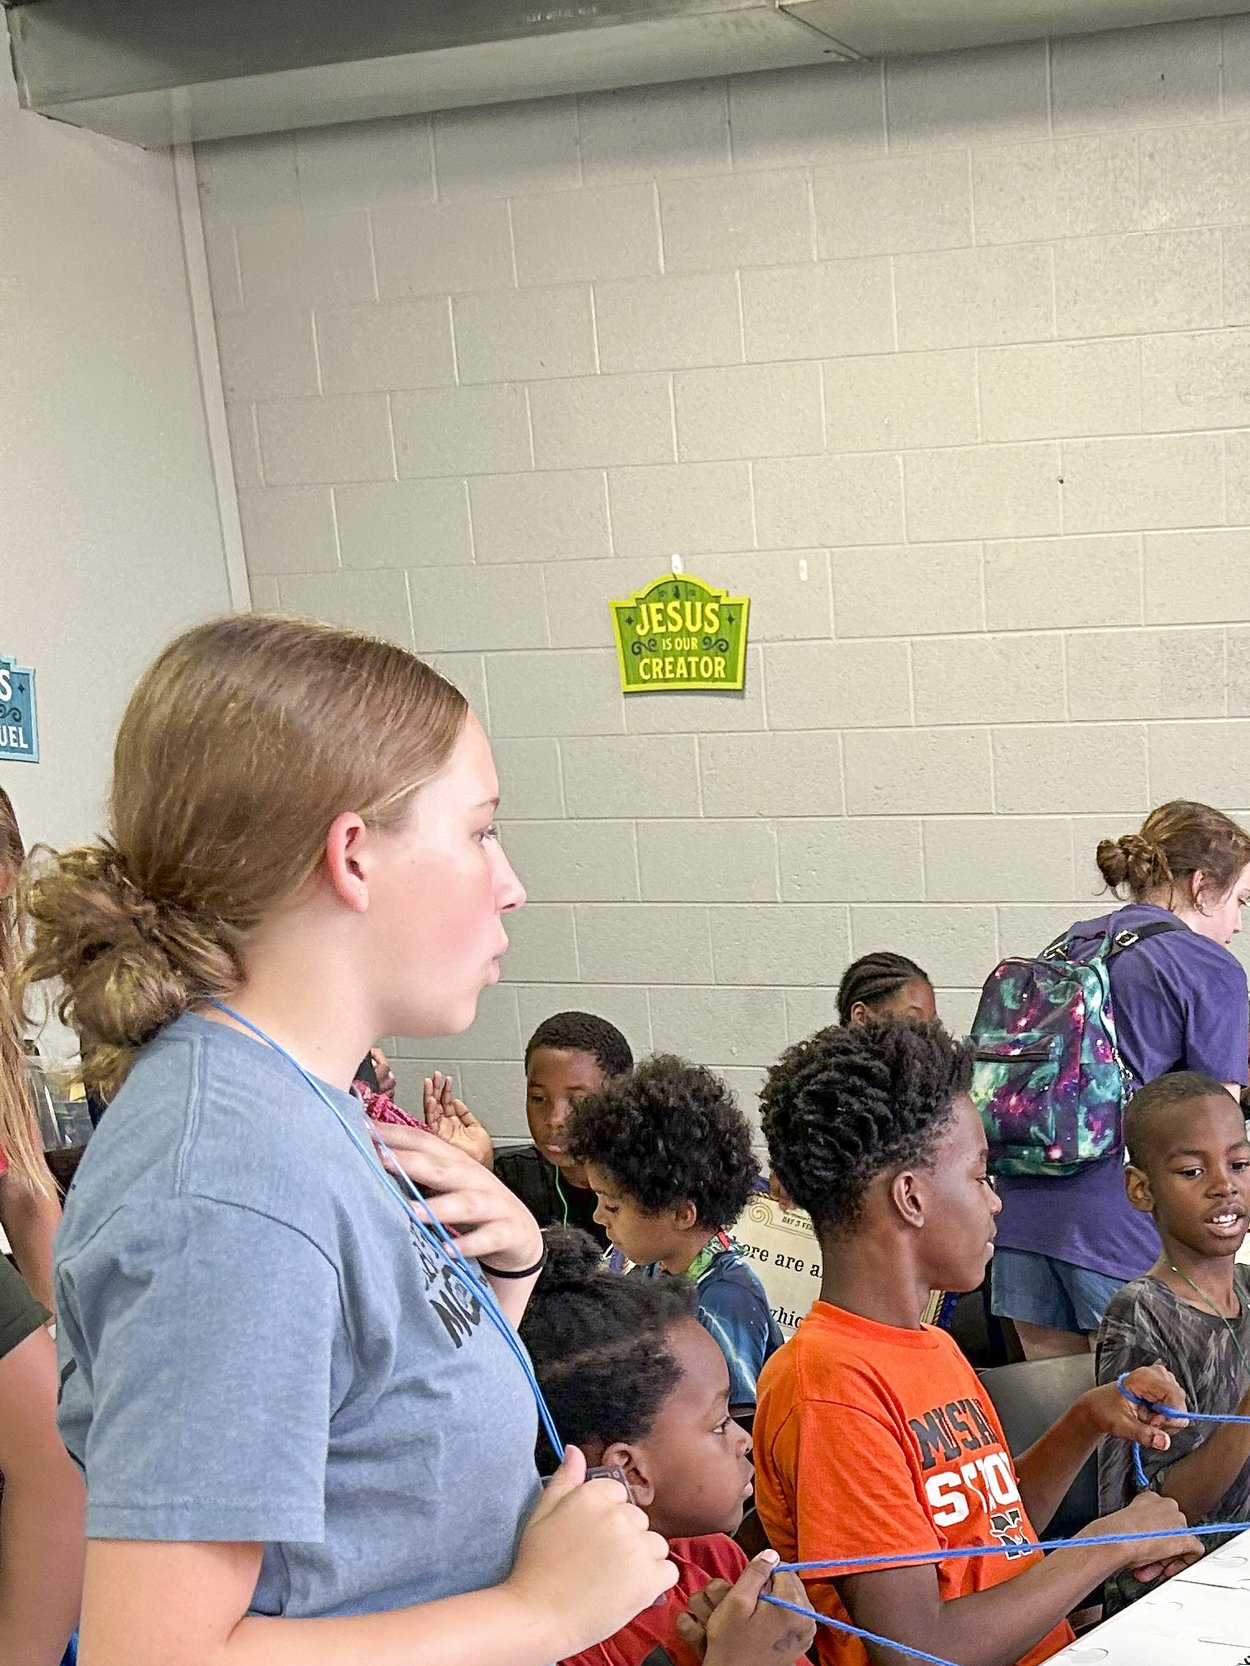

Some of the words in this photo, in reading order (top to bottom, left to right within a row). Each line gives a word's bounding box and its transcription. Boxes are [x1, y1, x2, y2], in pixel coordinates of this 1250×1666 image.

[635, 601, 721, 636] JESUS
[662, 638, 672, 651] IS
[674, 637, 699, 651] OUR
[638, 656, 727, 680] CREATOR
[774, 1253, 804, 1273] are
[809, 1264, 823, 1279] a
